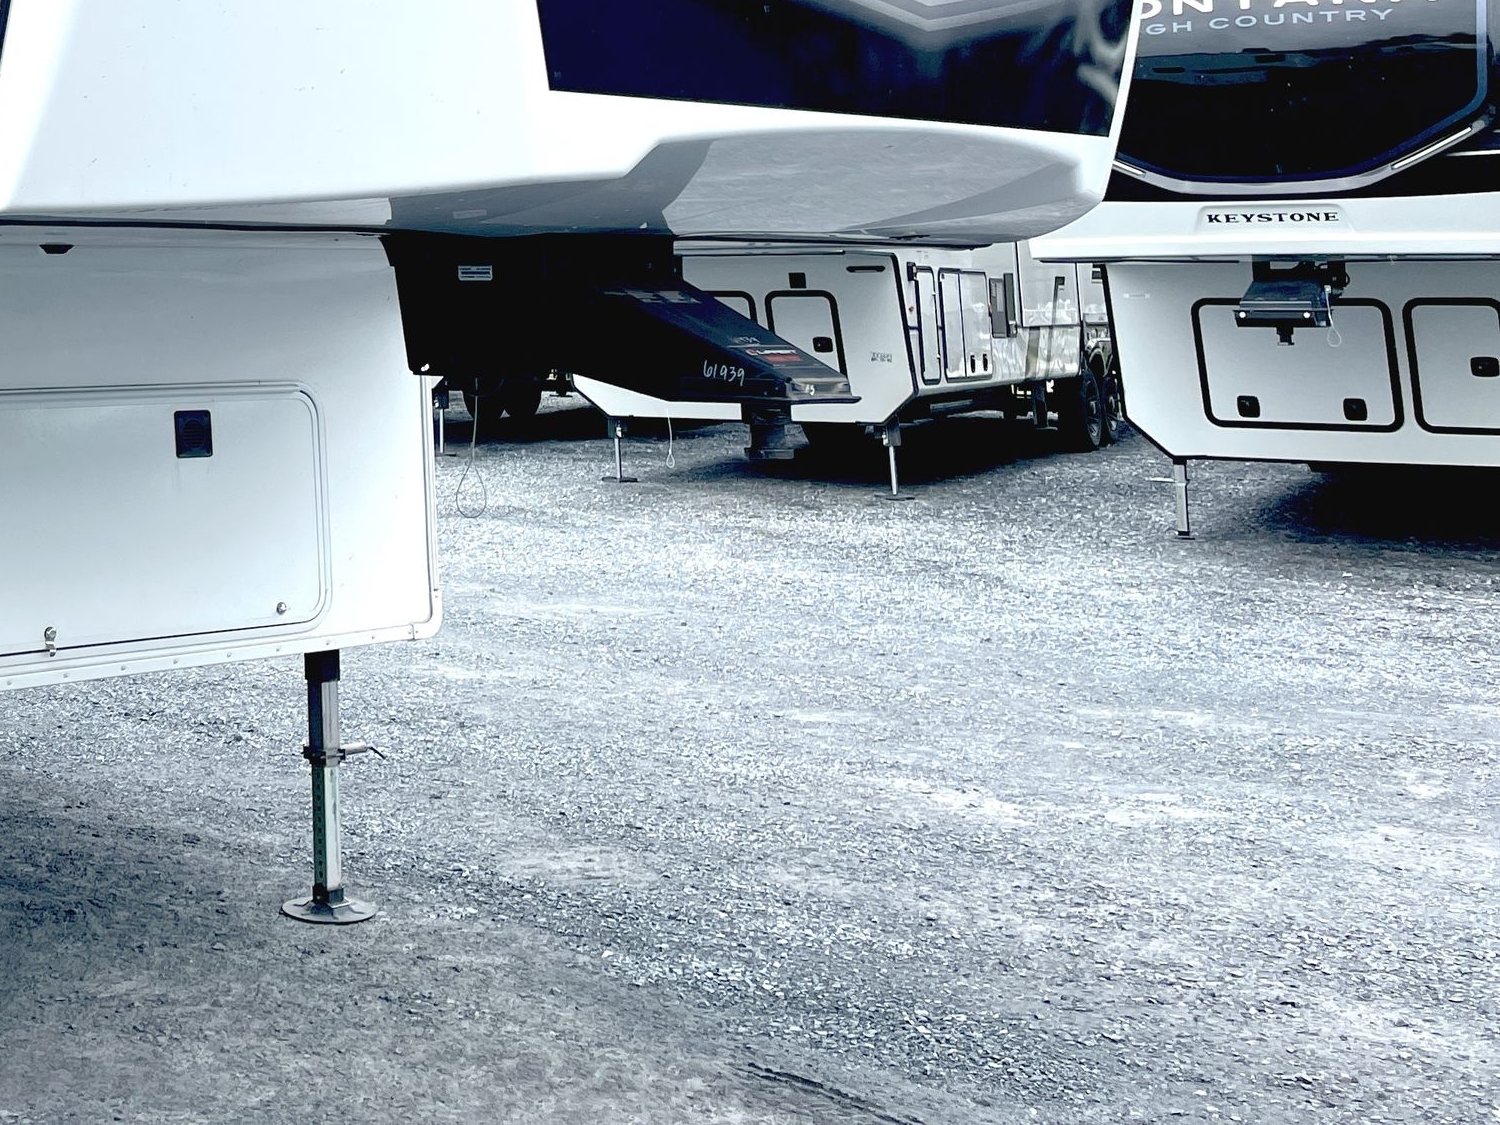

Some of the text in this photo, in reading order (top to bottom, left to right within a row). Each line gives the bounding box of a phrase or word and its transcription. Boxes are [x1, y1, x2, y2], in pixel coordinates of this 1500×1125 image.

[1145, 7, 1395, 36] GH COUNTRY
[1206, 211, 1340, 224] KEYSTONE
[702, 358, 746, 387] 61939
